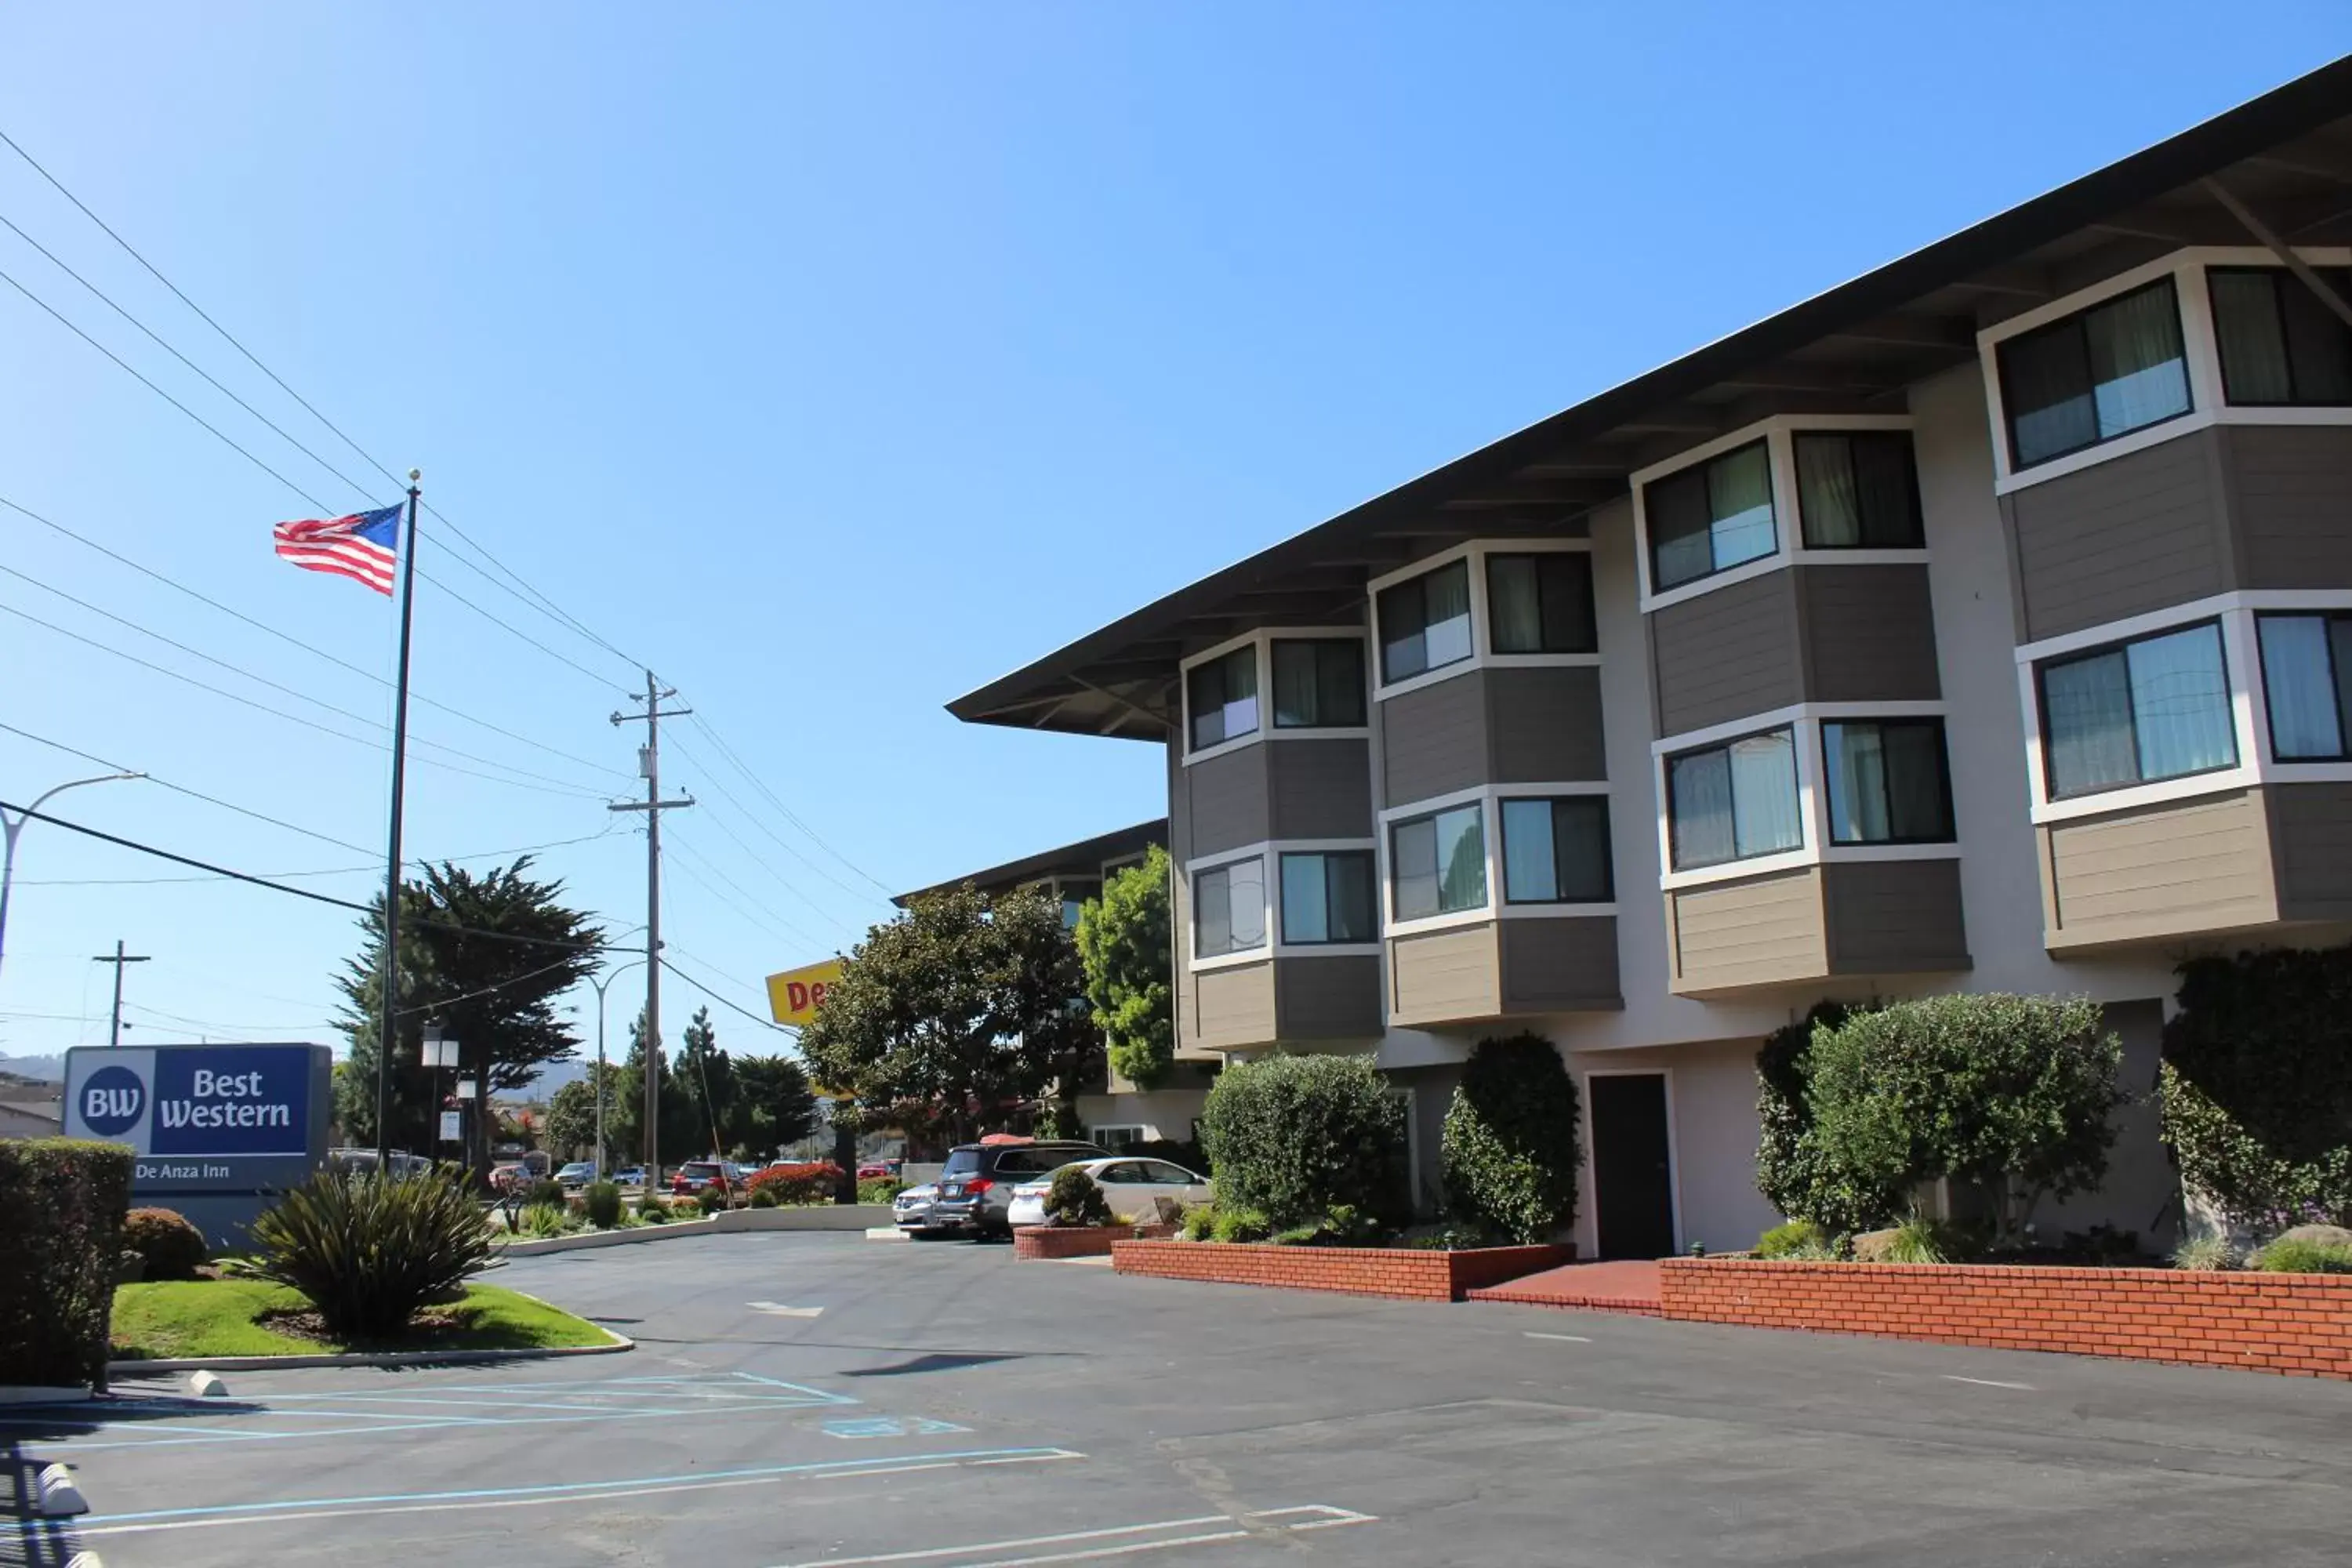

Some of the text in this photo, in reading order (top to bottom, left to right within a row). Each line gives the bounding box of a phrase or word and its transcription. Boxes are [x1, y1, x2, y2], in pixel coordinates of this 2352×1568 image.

[786, 982, 826, 1011] De
[193, 1069, 263, 1098] Best
[86, 1089, 140, 1118] BW
[160, 1099, 290, 1128] Western
[136, 1163, 230, 1179] De Anza Inn
